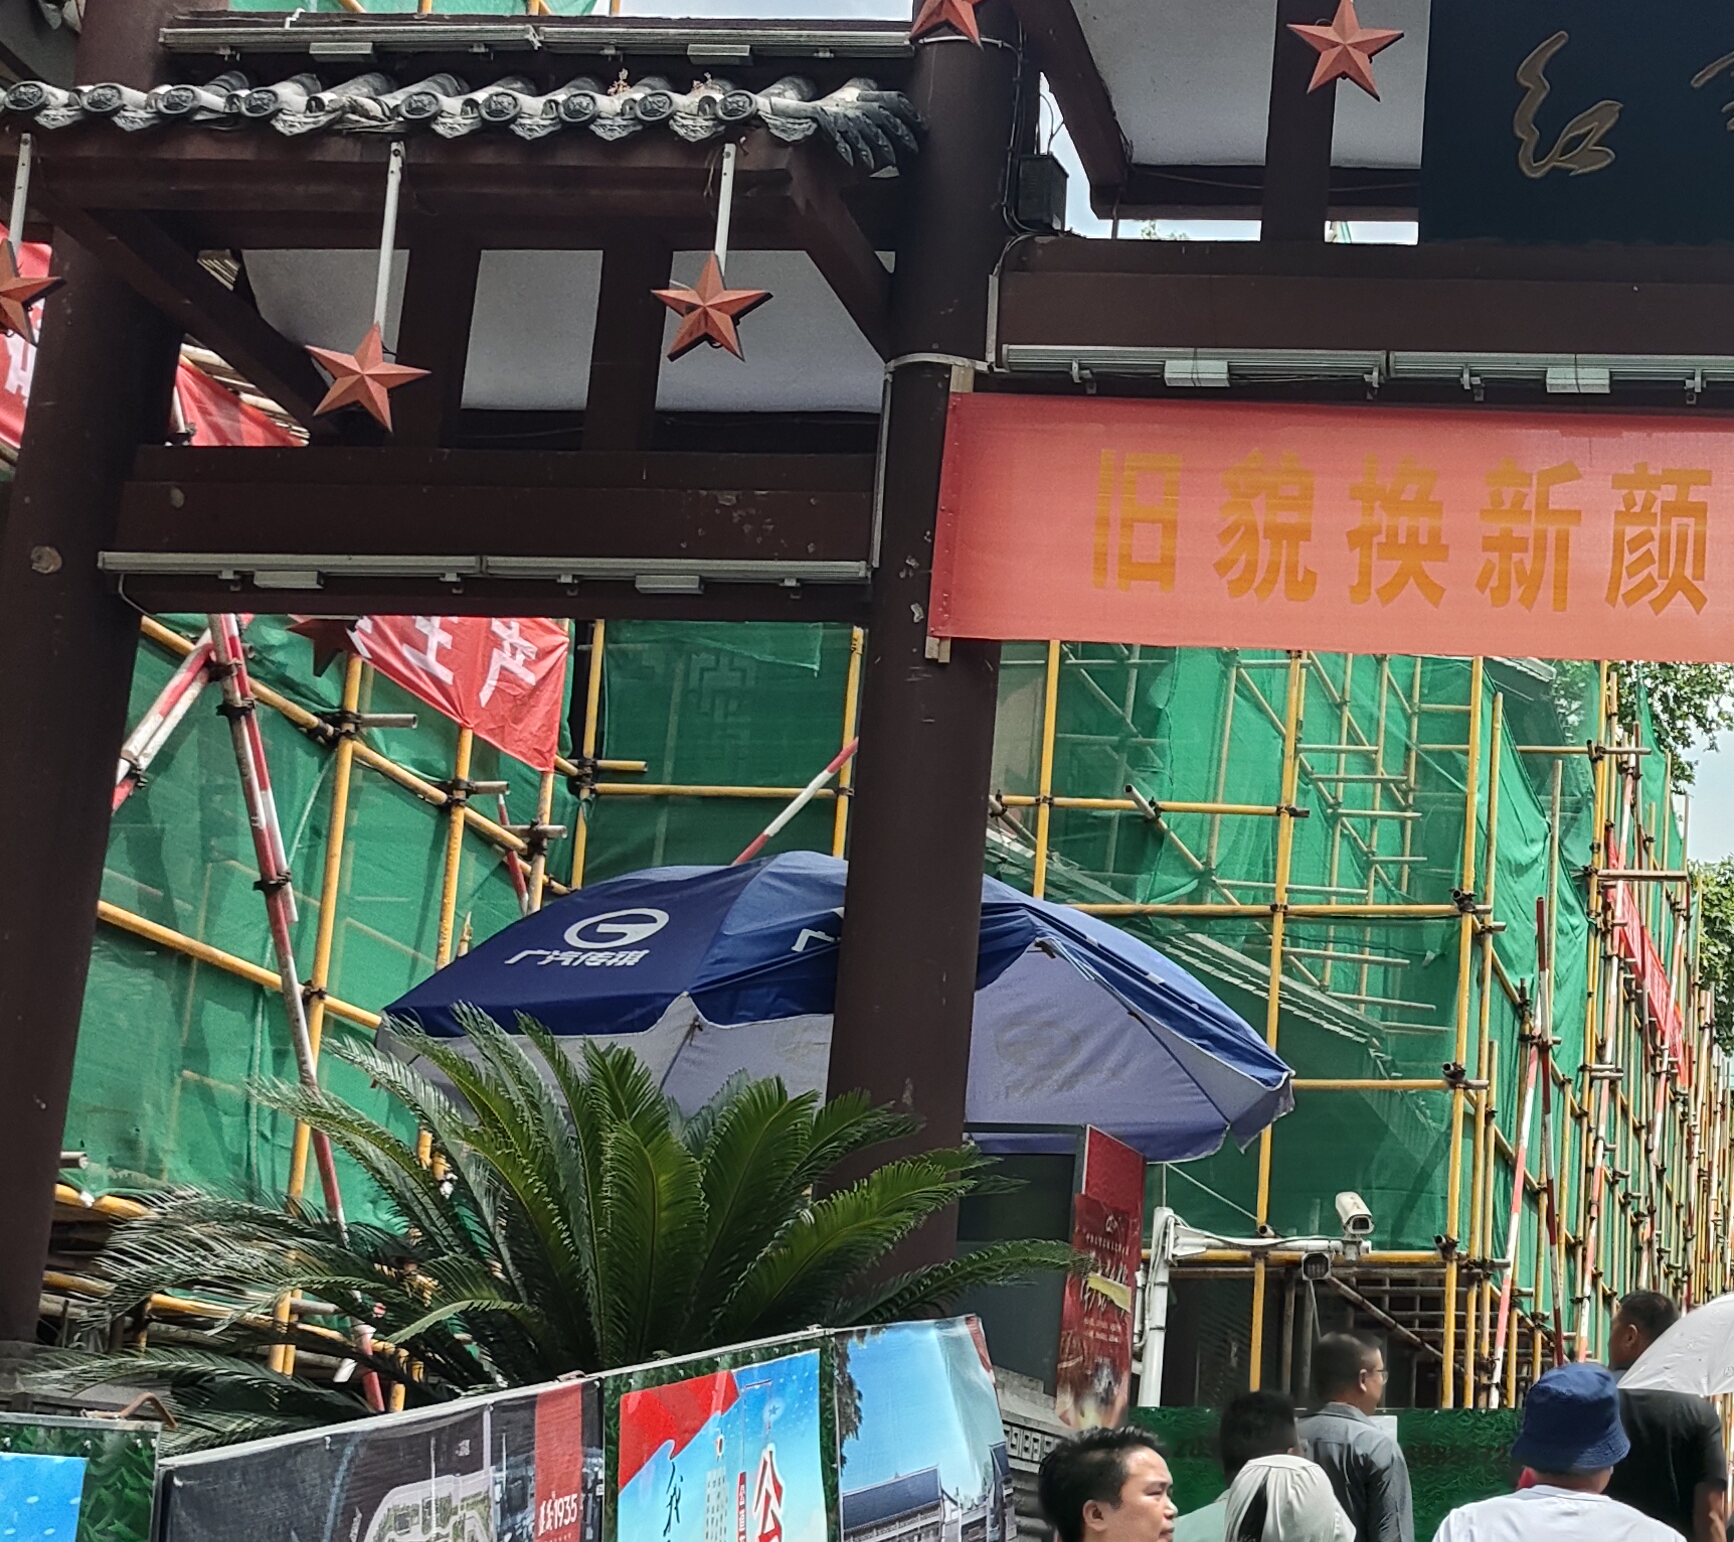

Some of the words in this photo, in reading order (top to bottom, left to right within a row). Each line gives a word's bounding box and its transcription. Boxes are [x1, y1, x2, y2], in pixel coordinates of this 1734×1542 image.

[1091, 447, 1713, 617] 旧貌换新颜
[504, 949, 650, 968] 广汽传祺
